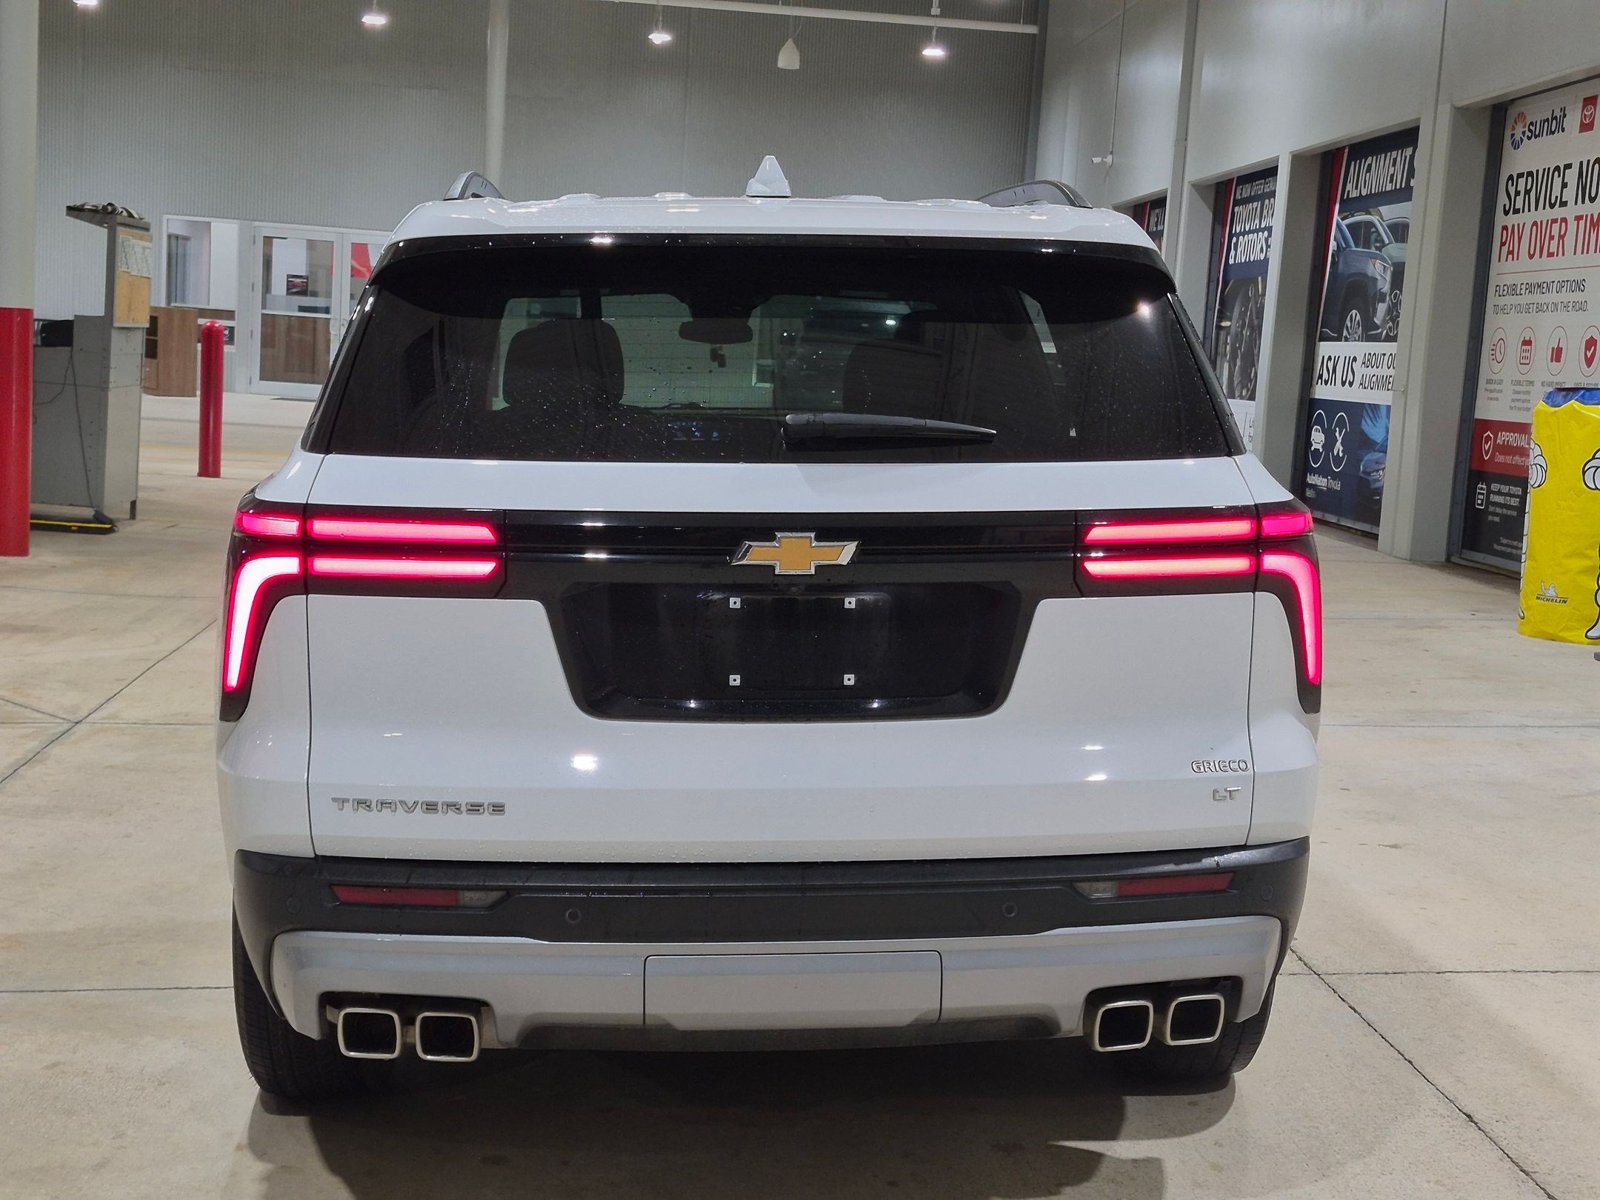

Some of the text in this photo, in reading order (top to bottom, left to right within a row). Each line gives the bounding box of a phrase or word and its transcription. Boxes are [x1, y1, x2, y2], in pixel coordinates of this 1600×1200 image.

[1526, 106, 1567, 141] sunbit
[1344, 146, 1414, 199] ALIGNMENT
[1503, 162, 1573, 216] SERVICE
[1232, 201, 1261, 234] TOYOTA
[1229, 237, 1237, 264] &
[1236, 231, 1268, 263] ROTORS
[1498, 222, 1526, 263] PAY
[1528, 216, 1569, 261] OVER
[1494, 278, 1586, 298] FLEXIBLE PAYMENT OPTIONS
[1493, 304, 1500, 315] TO
[1500, 303, 1514, 315] HELP
[1514, 303, 1524, 314] YOU
[1524, 302, 1535, 314] GET
[1535, 302, 1550, 313] BACK
[1550, 301, 1559, 313] ON
[1560, 301, 1571, 312] THE
[1316, 355, 1357, 388] ASK US
[1360, 352, 1386, 369] ABOUT
[1535, 595, 1568, 605] MICHELIN
[1191, 759, 1250, 774] GRIECO
[331, 797, 506, 816] TRAVERSE
[1212, 786, 1241, 801] LT
